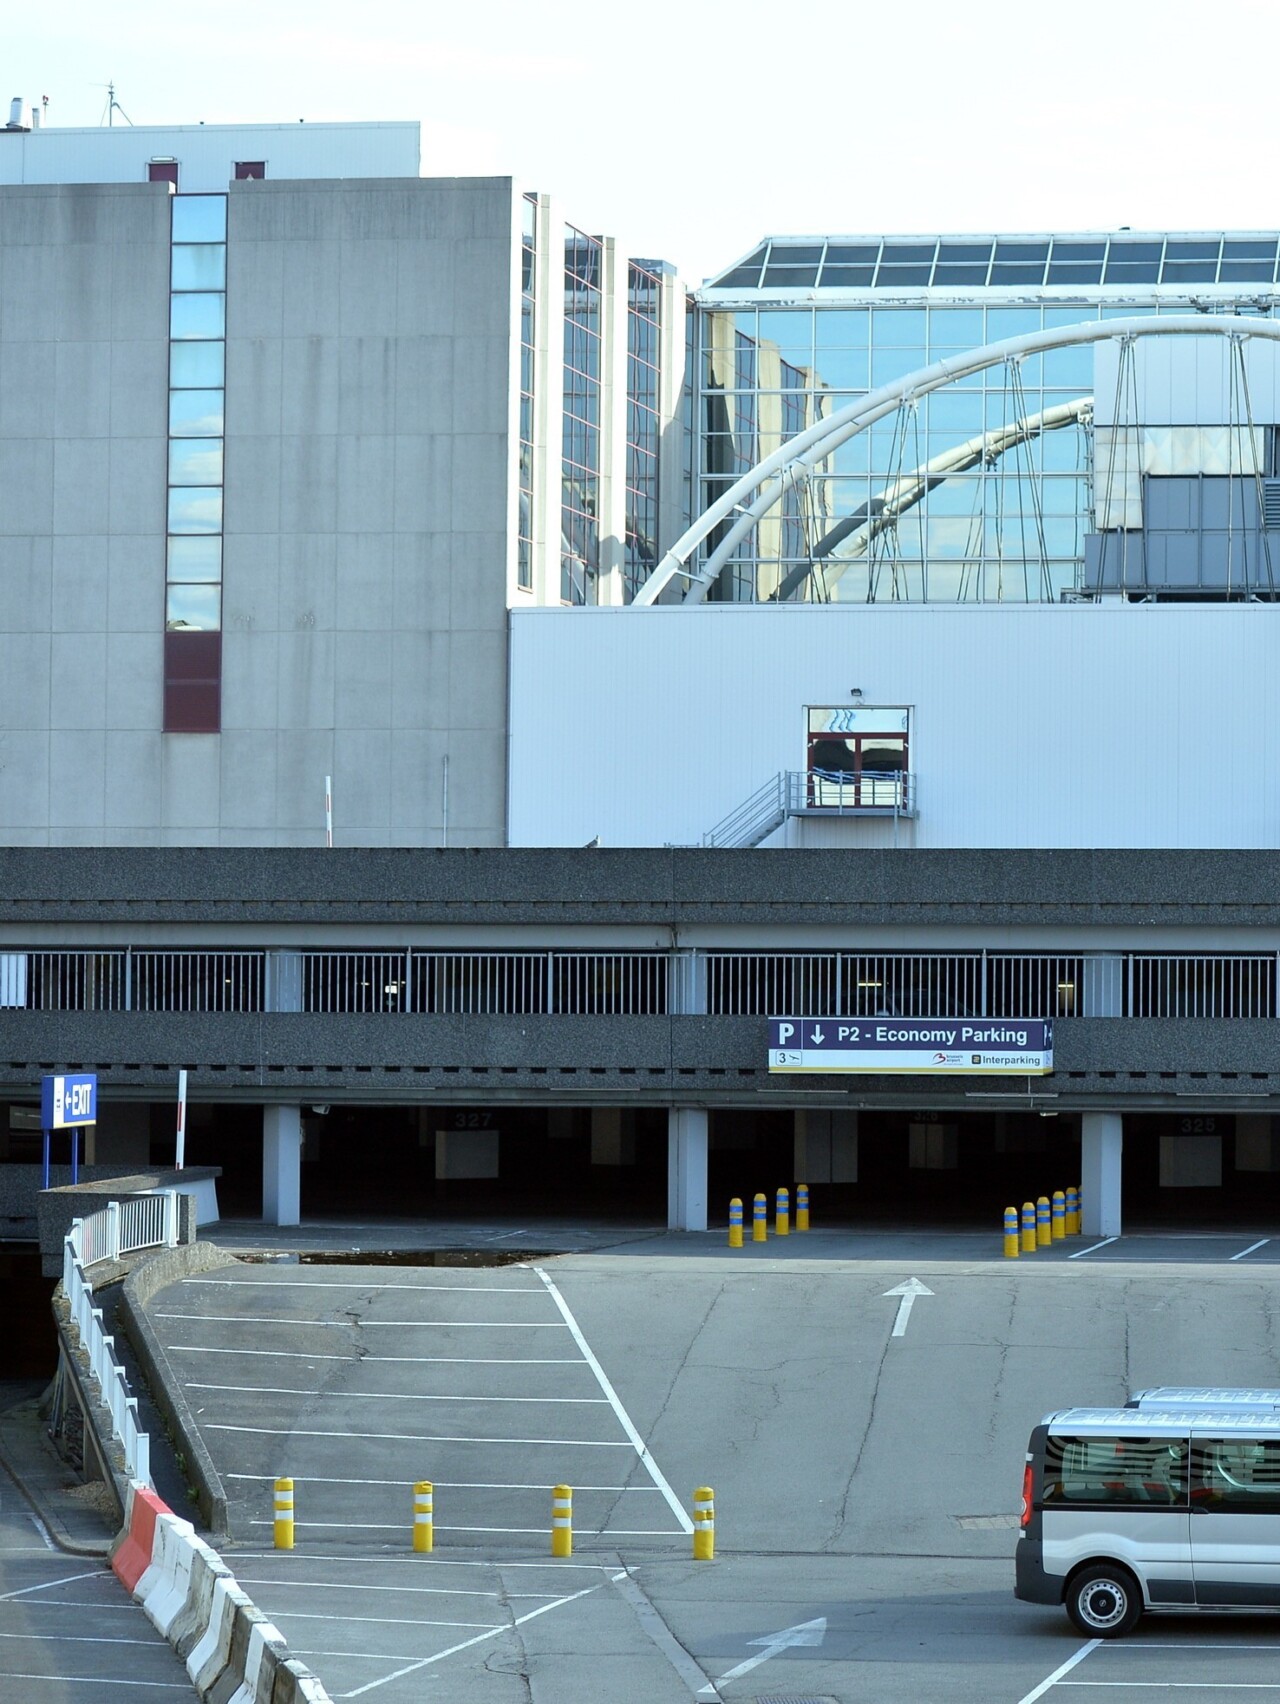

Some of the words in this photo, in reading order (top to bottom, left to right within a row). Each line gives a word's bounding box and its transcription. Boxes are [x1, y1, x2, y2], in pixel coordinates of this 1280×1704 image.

[778, 1022, 795, 1046] P
[837, 1026, 861, 1042] P2
[875, 1026, 957, 1046] Economy
[961, 1026, 1028, 1046] Parking
[778, 1052, 787, 1064] 3
[982, 1055, 1041, 1067] Interparking
[71, 1083, 93, 1116] EXIT
[454, 1112, 493, 1128] 327
[1180, 1117, 1216, 1133] 325
